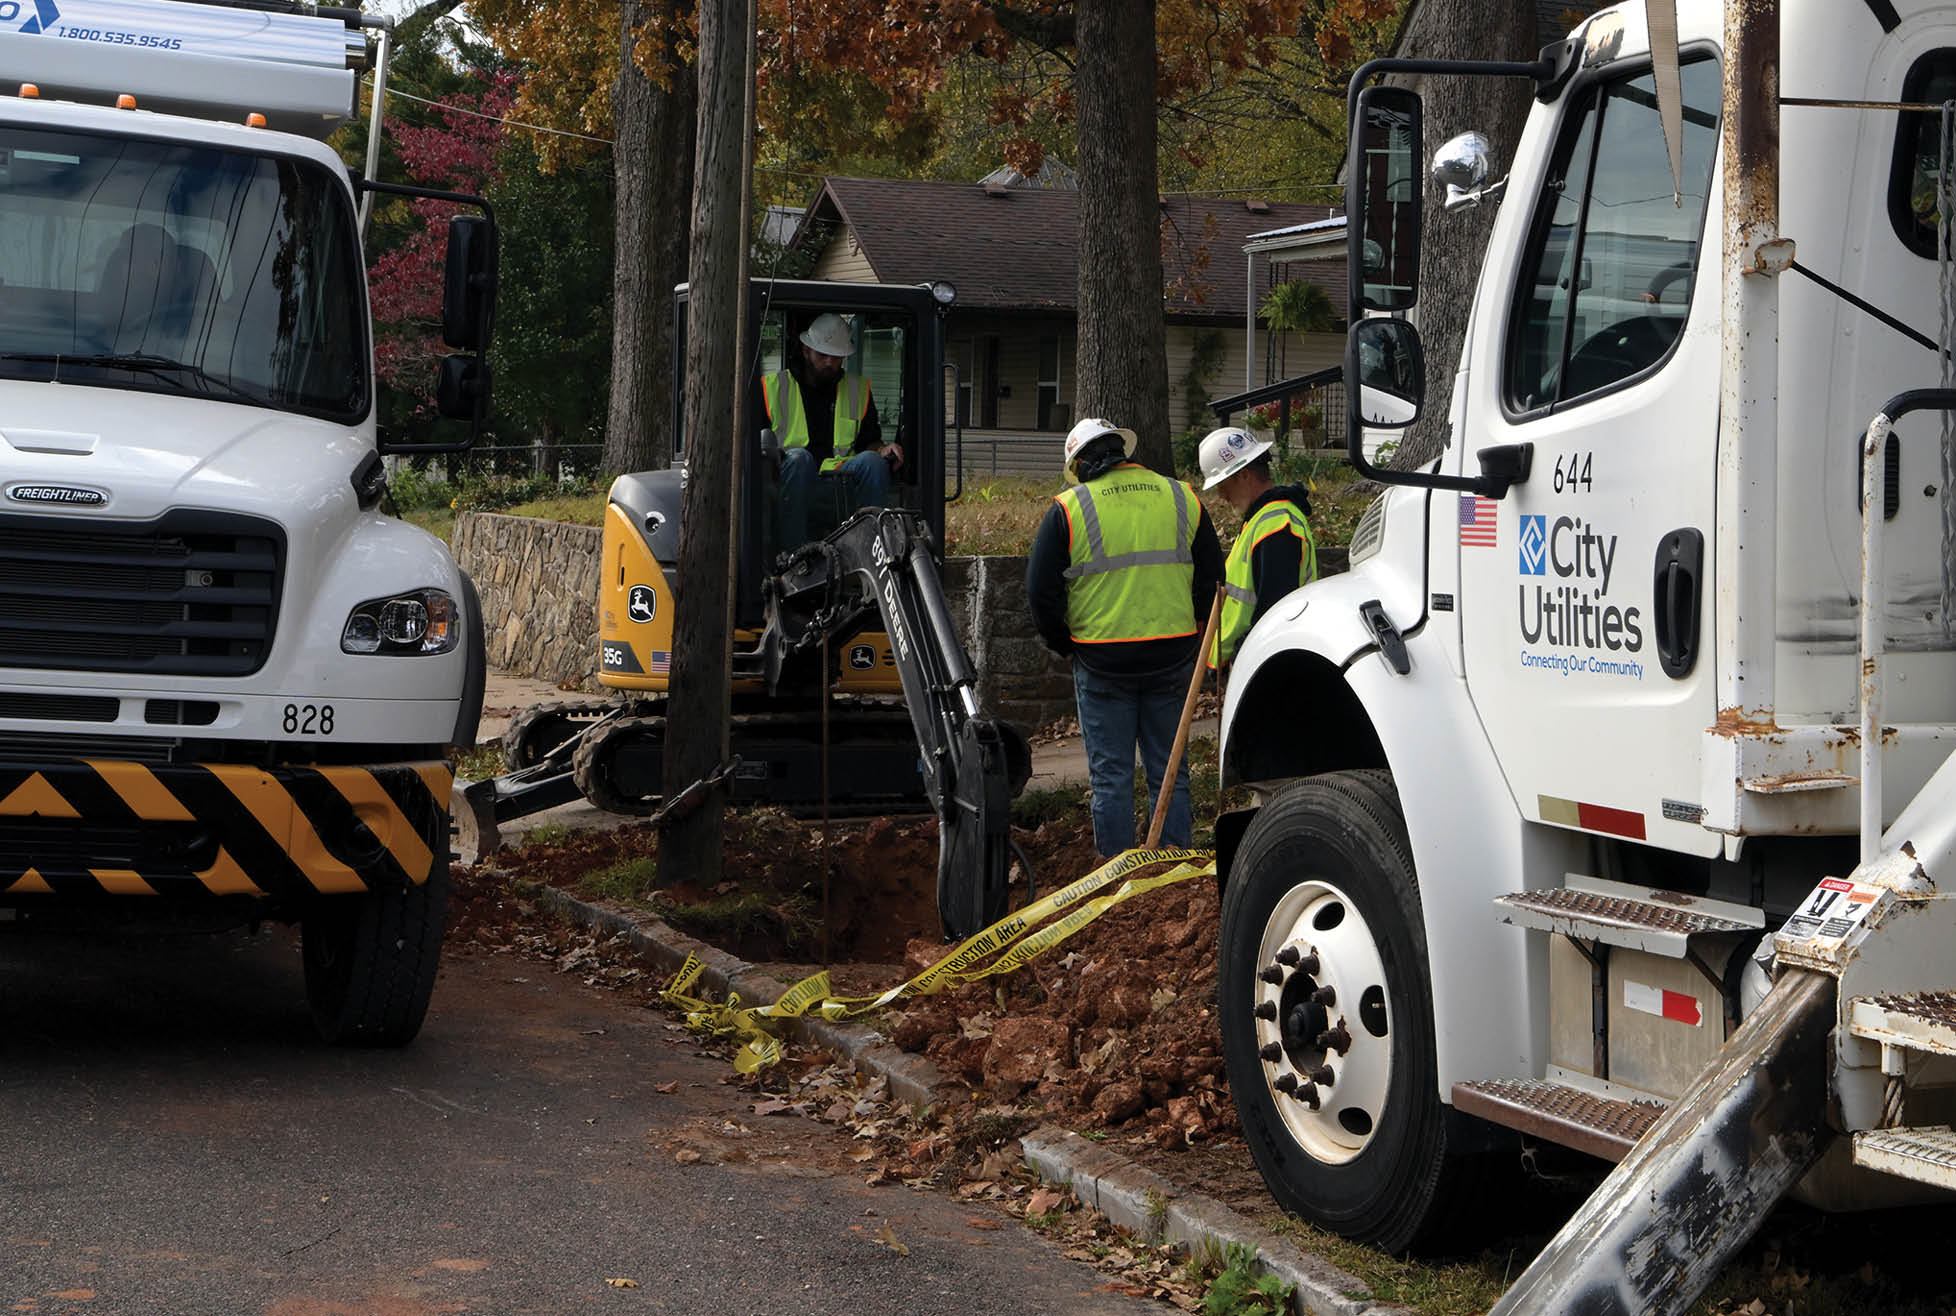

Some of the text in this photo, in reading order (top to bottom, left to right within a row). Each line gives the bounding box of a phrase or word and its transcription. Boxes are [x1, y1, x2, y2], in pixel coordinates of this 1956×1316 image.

[58, 26, 182, 50] 1.800.535.9545
[1553, 452, 1592, 494] 644
[16, 488, 99, 502] FREIGHTLINER
[1101, 483, 1160, 496] CITY UTILITIES
[1551, 516, 1618, 596] City
[884, 579, 909, 661] DEERE
[1519, 585, 1643, 652] Utilities
[604, 647, 622, 665] 35G
[1521, 650, 1643, 680] Connecting Our Community
[283, 704, 334, 735] 828
[995, 916, 1027, 944] AREA
[1053, 875, 1103, 907] CAUTION
[1104, 850, 1191, 881] CONSTRUCTION
